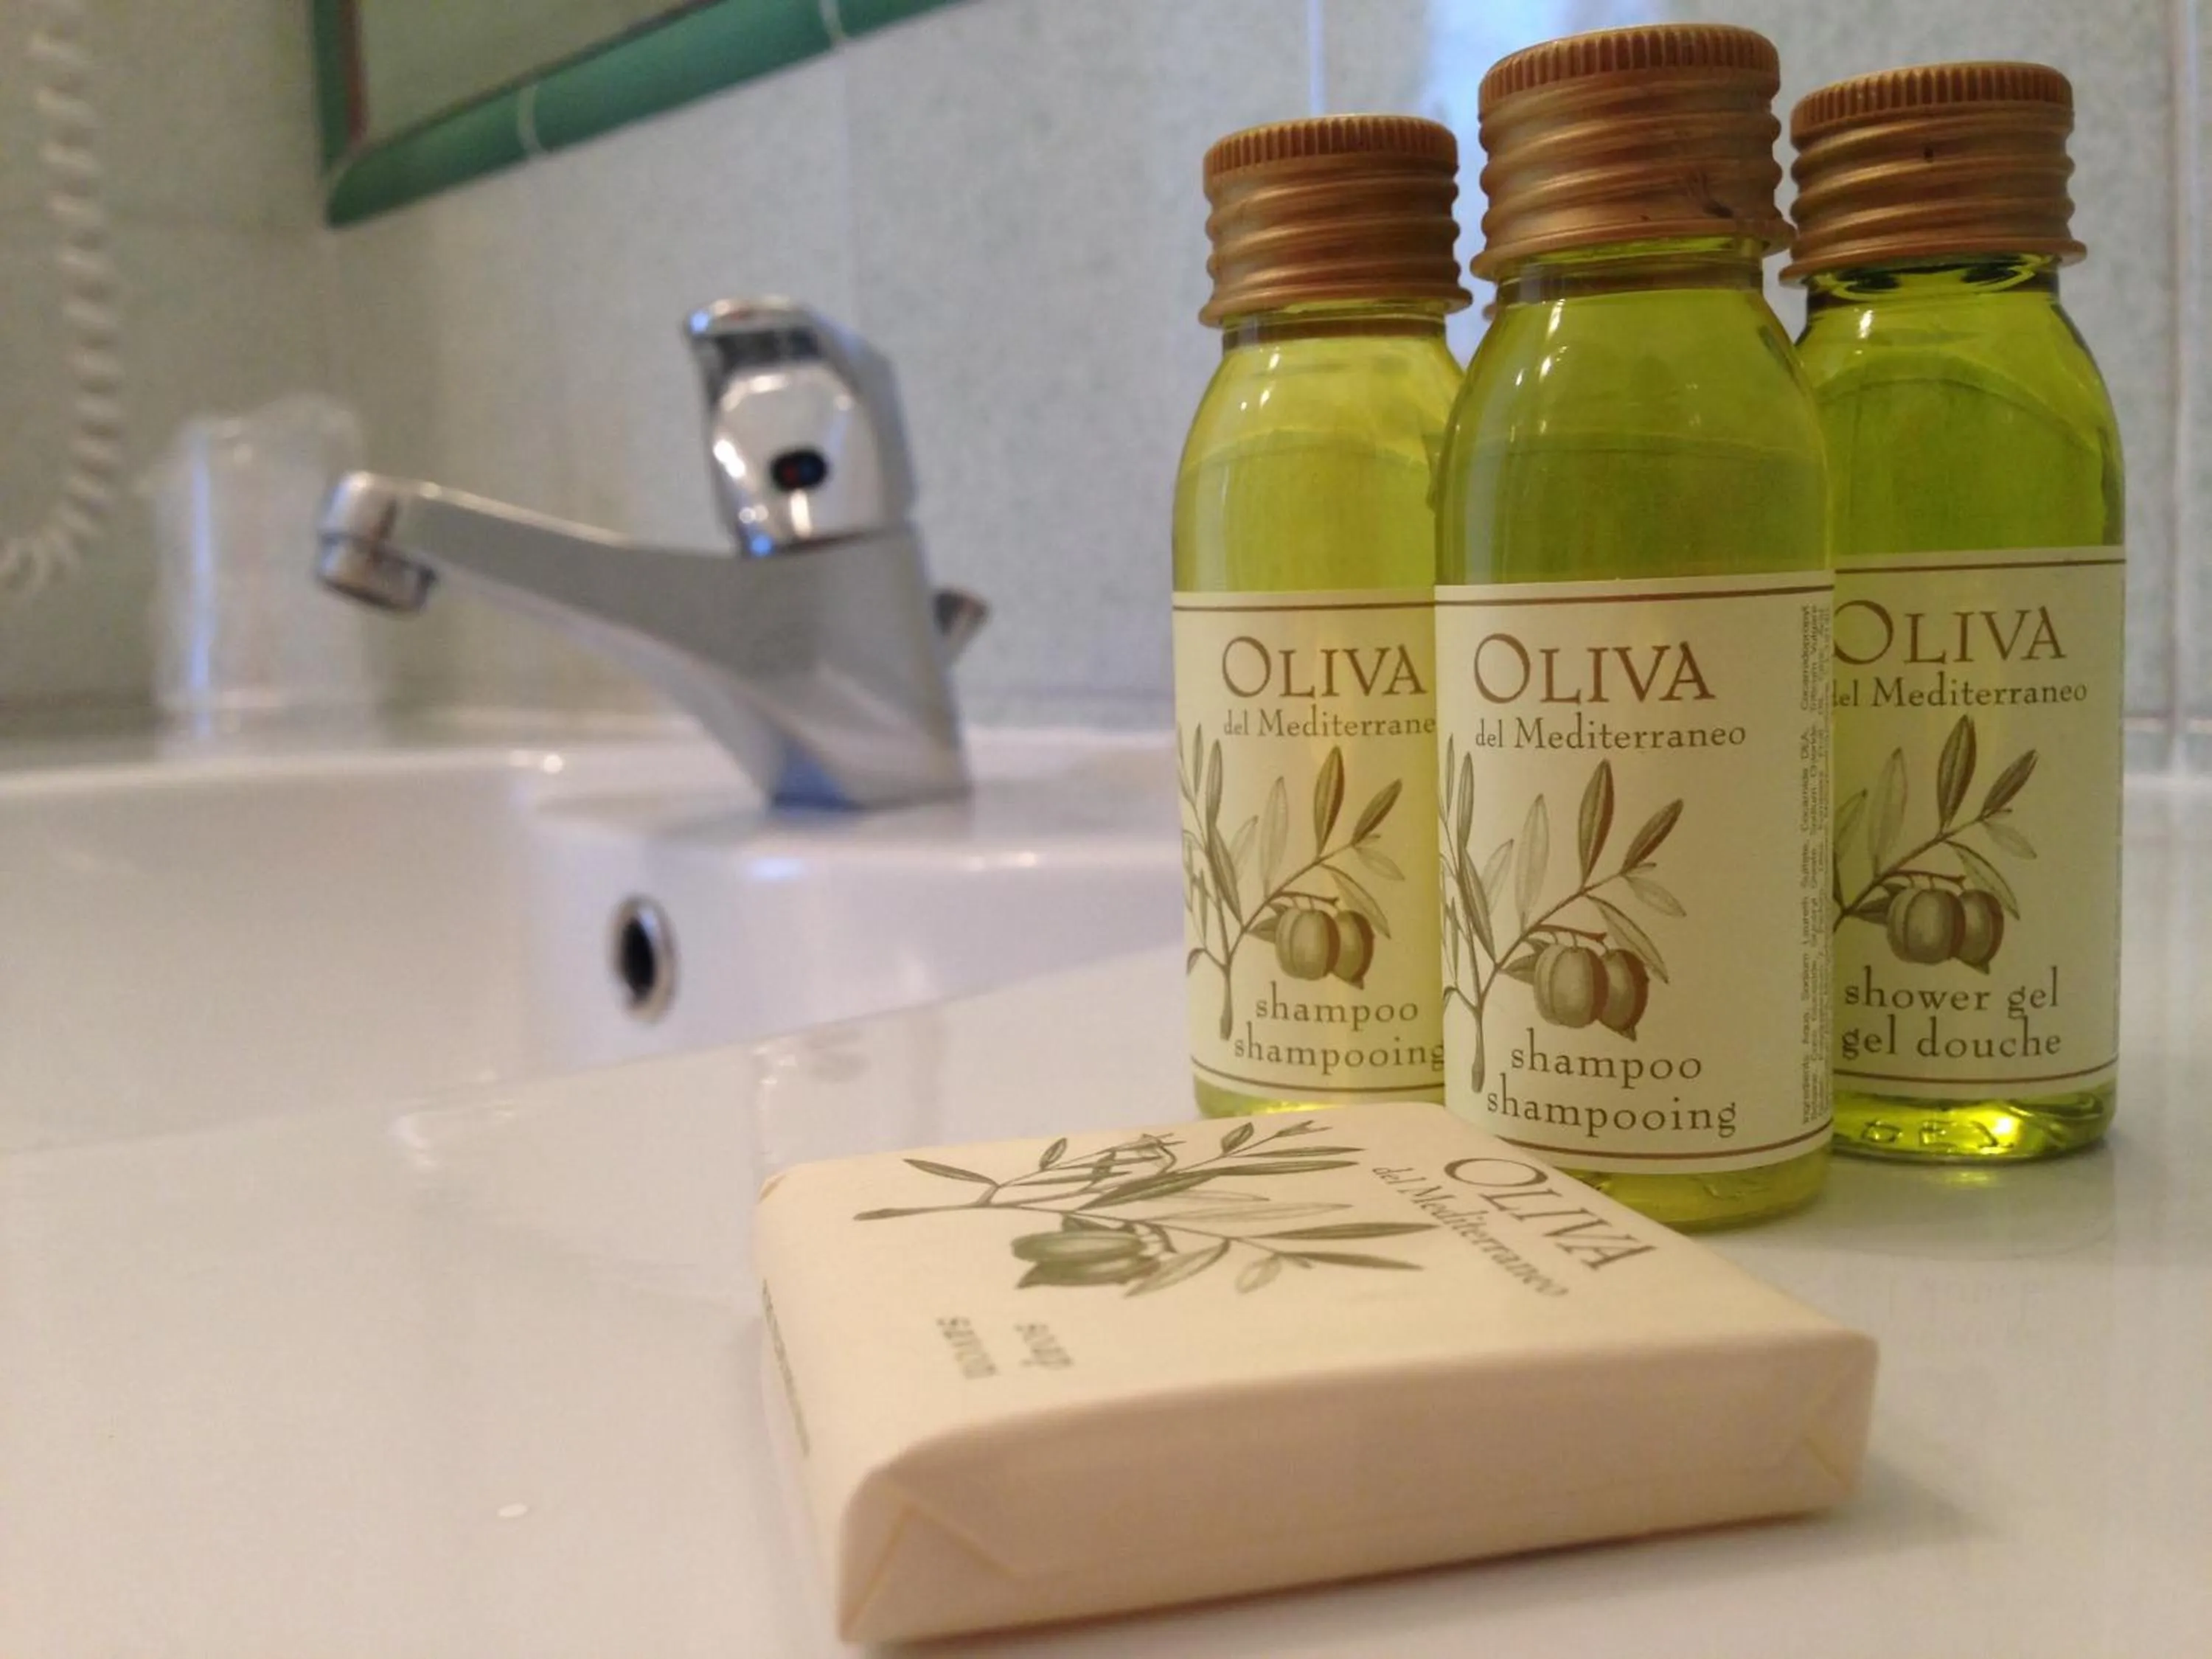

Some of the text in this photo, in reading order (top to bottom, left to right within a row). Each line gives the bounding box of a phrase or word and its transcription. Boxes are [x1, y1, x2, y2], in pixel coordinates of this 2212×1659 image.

[1833, 599, 2067, 665] OLIVA
[1222, 636, 1427, 698] OLIVA
[1474, 633, 1716, 704] OLIVA
[1832, 671, 2087, 708] el Mediterraneo
[1224, 704, 1436, 737] del Mediterrane
[1475, 711, 1746, 751] del Mediterraneo
[1256, 981, 1418, 1032] shampoo
[1845, 966, 2059, 1019] shower gel
[1234, 1021, 1444, 1075] shampooing
[1511, 1027, 1702, 1089] shampoo
[1842, 1014, 2062, 1061] gel douche
[1486, 1072, 1737, 1138] shampooing
[1372, 1167, 1568, 1296] del Mediterraneo
[1444, 1158, 1657, 1271] OLIVA
